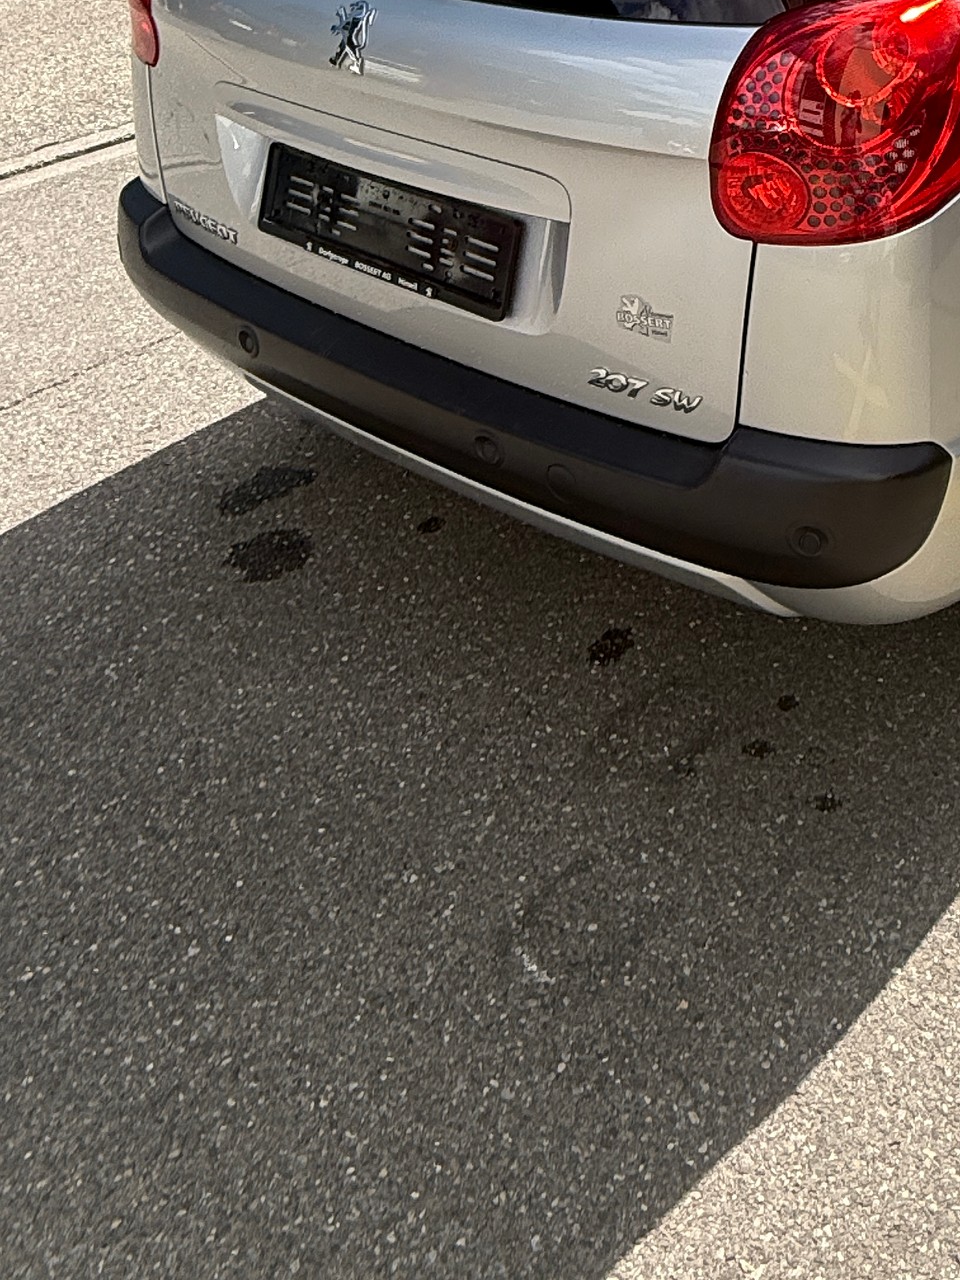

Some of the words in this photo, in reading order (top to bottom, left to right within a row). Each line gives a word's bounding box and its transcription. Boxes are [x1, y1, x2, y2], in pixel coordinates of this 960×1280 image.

[173, 200, 239, 245] PEUGEOT
[354, 260, 383, 277] BOSSERT
[381, 271, 392, 281] AG
[616, 310, 672, 329] BOSSERT
[587, 366, 650, 399] 207
[649, 386, 703, 414] SW
